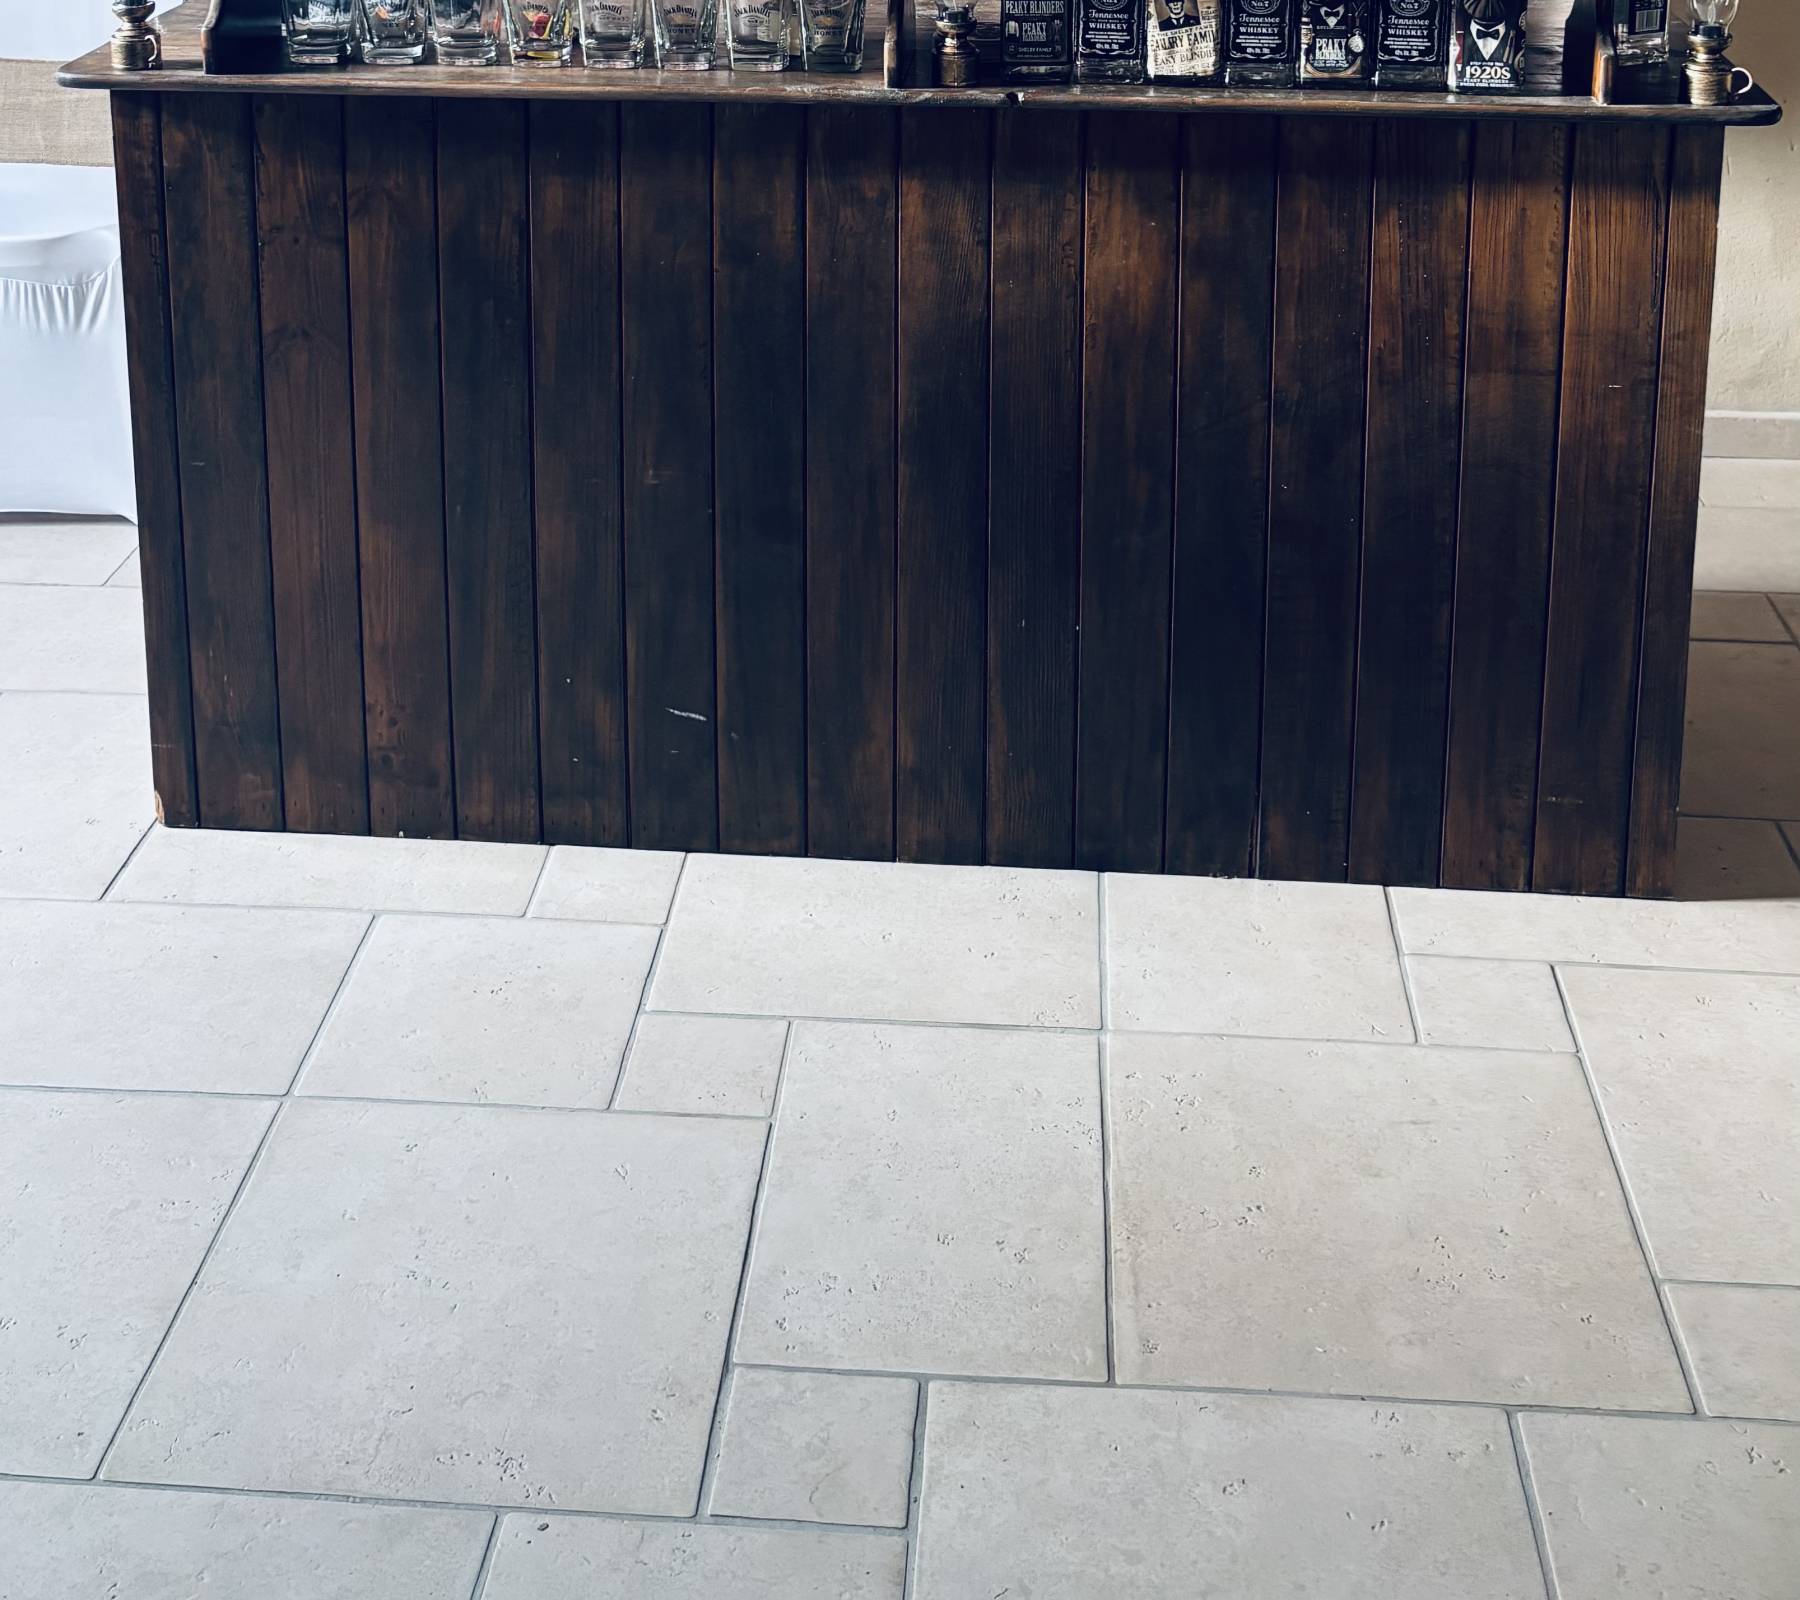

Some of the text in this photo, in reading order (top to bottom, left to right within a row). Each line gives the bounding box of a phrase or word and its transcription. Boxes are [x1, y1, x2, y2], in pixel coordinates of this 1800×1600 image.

[1005, 0, 1064, 14] PEAKY BLINDERS
[1022, 22, 1047, 35] PEAKY
[1088, 22, 1128, 30] WHISKEY
[1239, 26, 1280, 34] WHISKEY
[1387, 28, 1429, 36] WHISKEY
[1465, 65, 1511, 80] 1920S
